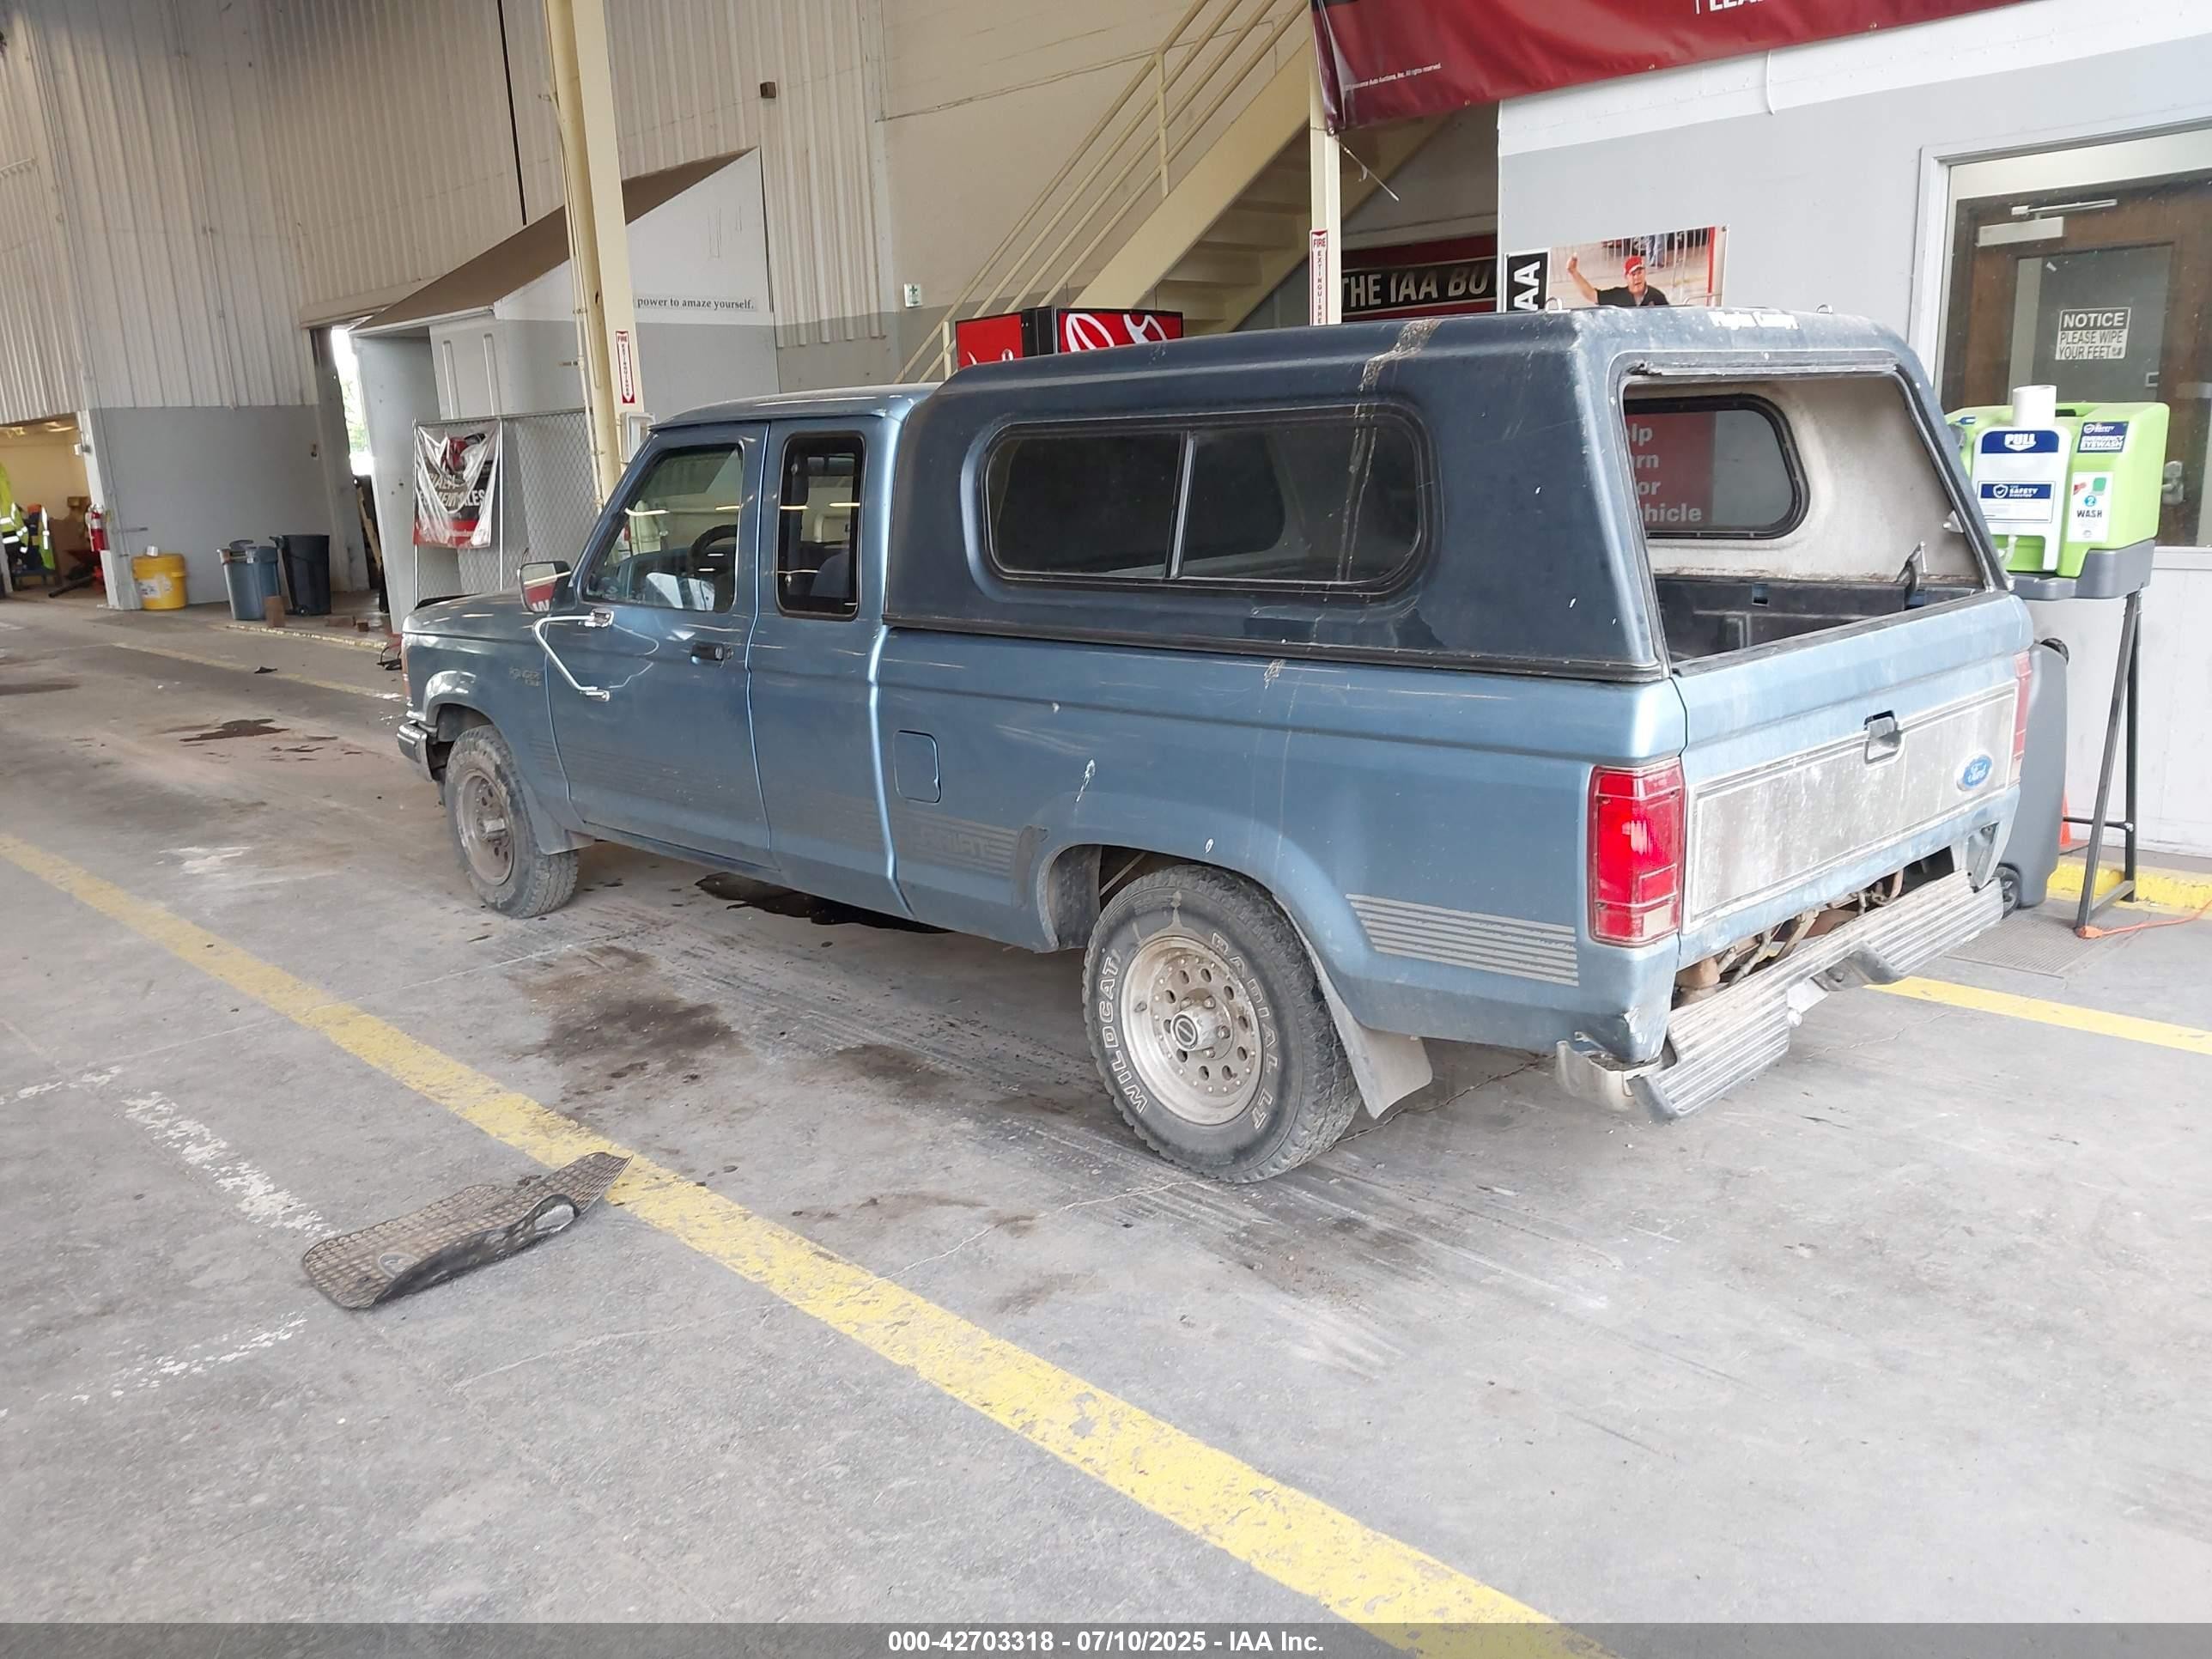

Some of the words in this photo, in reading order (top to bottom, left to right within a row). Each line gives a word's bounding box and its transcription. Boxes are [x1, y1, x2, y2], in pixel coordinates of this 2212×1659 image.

[1313, 238, 1327, 247] FIRE
[1390, 269, 1438, 303] IAA
[1448, 264, 1494, 297] BU
[637, 298, 668, 308] power
[670, 297, 679, 307] to
[682, 300, 712, 308] amaze
[714, 299, 754, 311] yourself.
[2063, 312, 2125, 328] NOTICE
[2061, 331, 2097, 344] PLEASE
[2100, 330, 2124, 343] WIPE
[2060, 345, 2085, 359] YOUR
[2087, 344, 2112, 358] FEET
[1626, 423, 1653, 447] lp
[2003, 433, 2036, 447] PULL
[1636, 479, 1662, 495] or
[2087, 496, 2095, 507] 2
[1641, 503, 1702, 523] hicle
[2076, 509, 2103, 519] WASH
[1098, 955, 1149, 1115] WILDCAT
[1212, 932, 1279, 1075] RADIAL
[1251, 1087, 1273, 1132] LT
